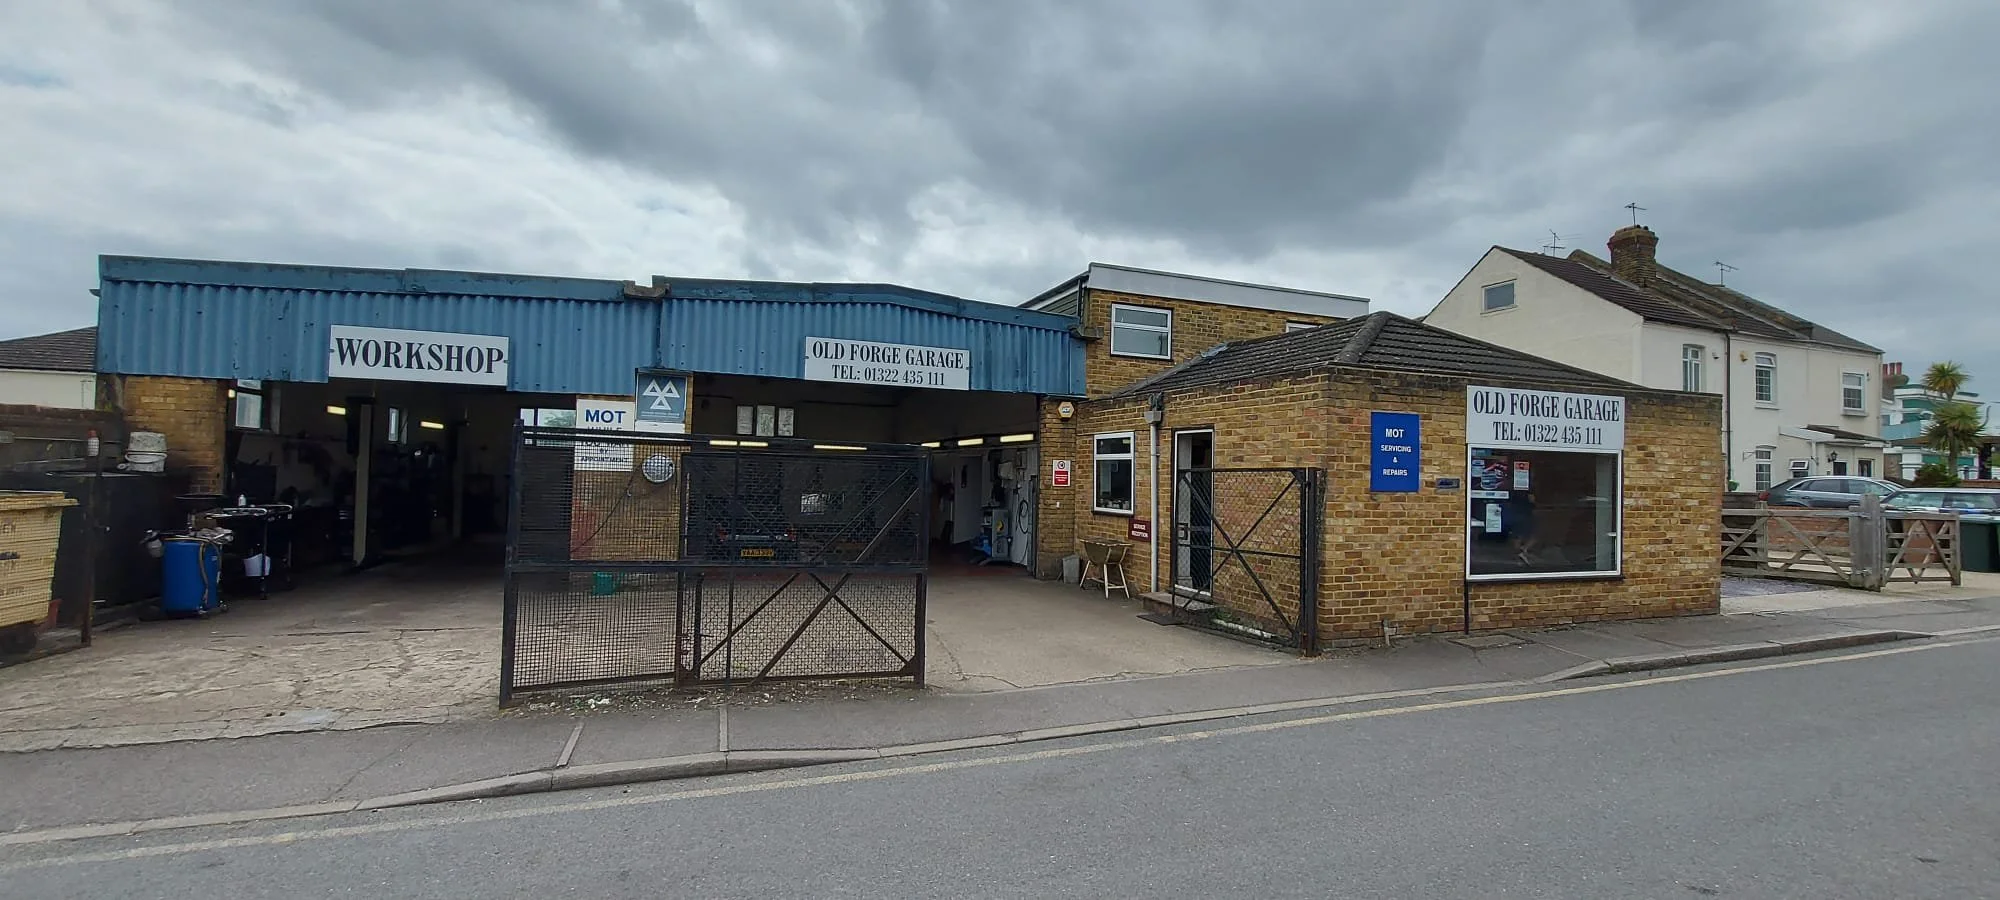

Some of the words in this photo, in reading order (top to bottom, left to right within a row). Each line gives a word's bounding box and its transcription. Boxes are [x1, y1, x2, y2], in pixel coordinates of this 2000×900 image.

[336, 337, 504, 374] WORKSHOP
[813, 341, 845, 360] OLD
[850, 343, 901, 365] FORGE
[906, 349, 964, 369] GARAGE
[832, 364, 861, 381] TEL:
[864, 367, 899, 383] 01322
[902, 370, 923, 385] 435
[928, 372, 945, 386] 111
[585, 409, 626, 424] MOT
[1473, 390, 1505, 415] OLD
[1510, 393, 1560, 418] FORGE
[1564, 397, 1620, 422] GARAGE
[1385, 428, 1404, 438] MOT
[1493, 421, 1521, 441] TEL:
[1524, 423, 1558, 443] 01322
[1561, 426, 1581, 444] 435
[1585, 427, 1602, 445] 111
[1380, 444, 1412, 453] SERVICING
[1382, 468, 1408, 476] REPAIRS
